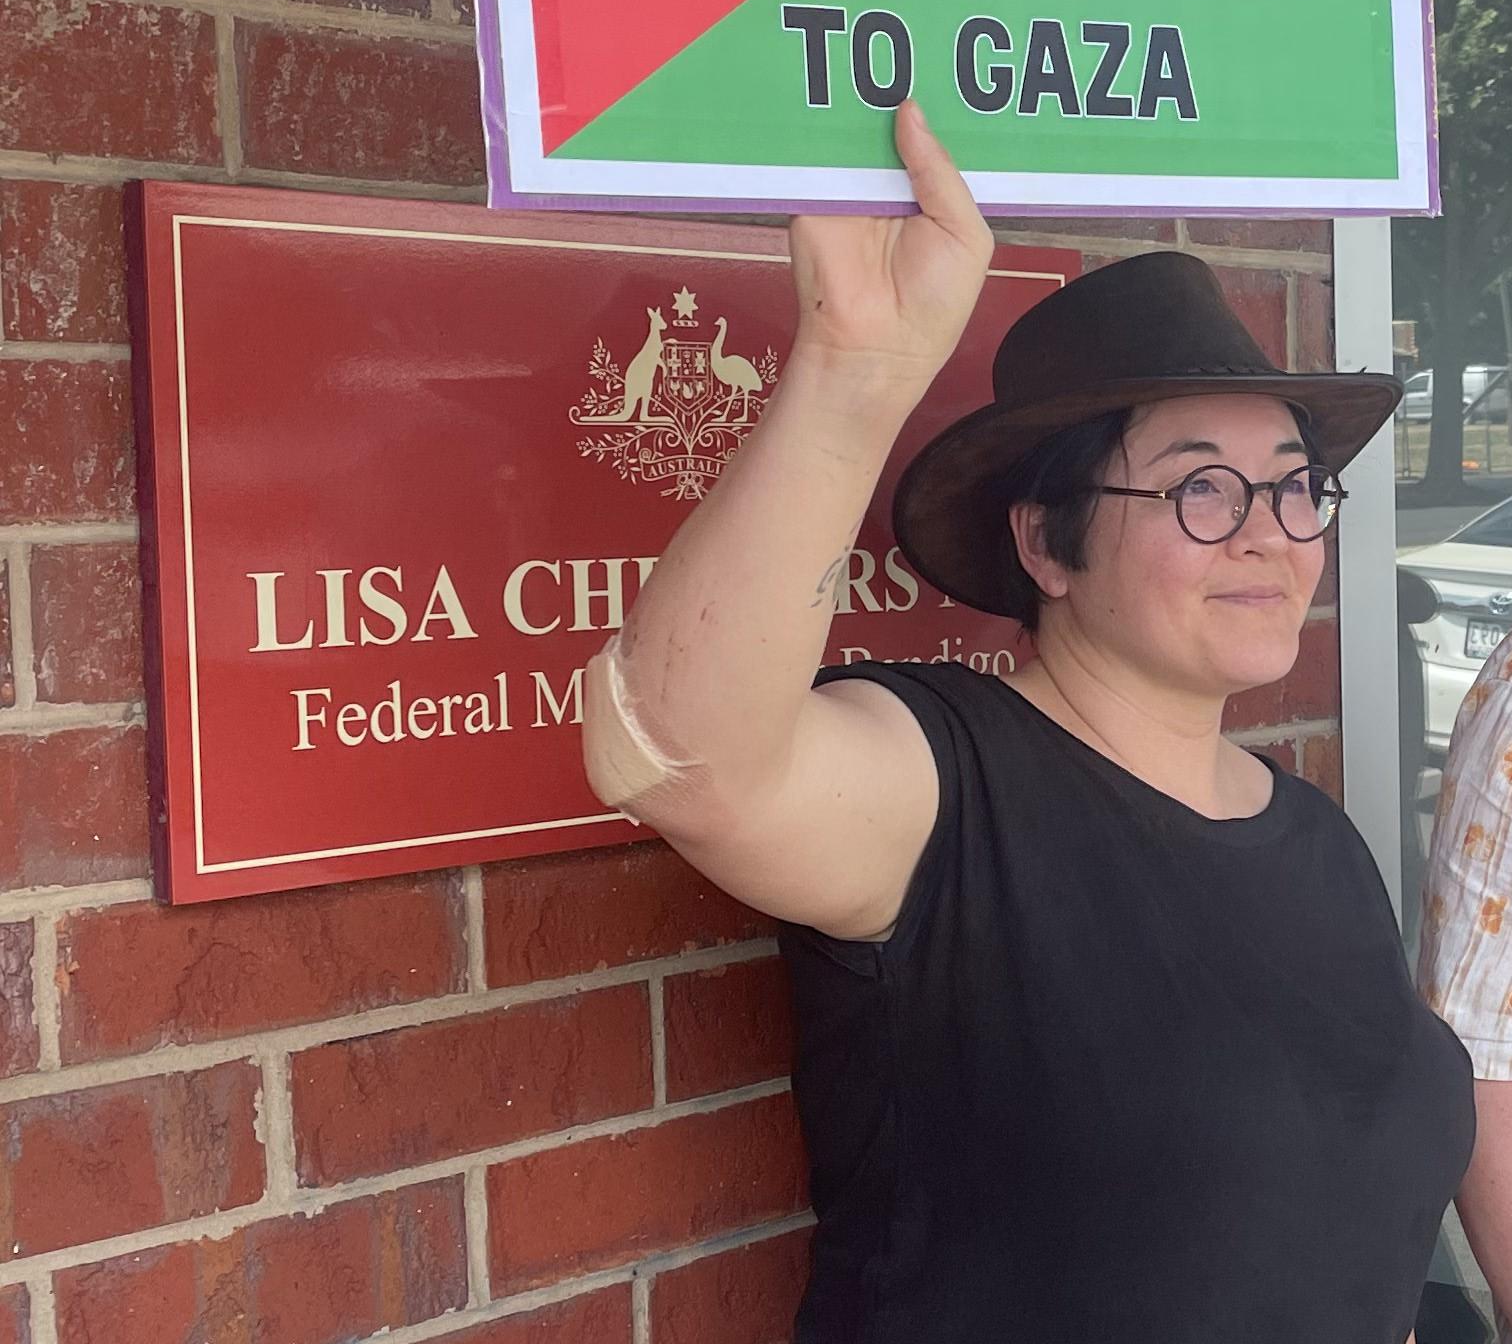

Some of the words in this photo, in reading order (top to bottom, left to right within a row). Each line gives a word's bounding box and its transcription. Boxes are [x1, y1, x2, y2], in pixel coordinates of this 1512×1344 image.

[782, 4, 913, 109] TO
[955, 16, 1199, 121] GAZA
[648, 458, 721, 477] AUSTRALI
[246, 564, 479, 653] LISA
[502, 545, 919, 635] CHRS
[290, 672, 513, 752] Federal
